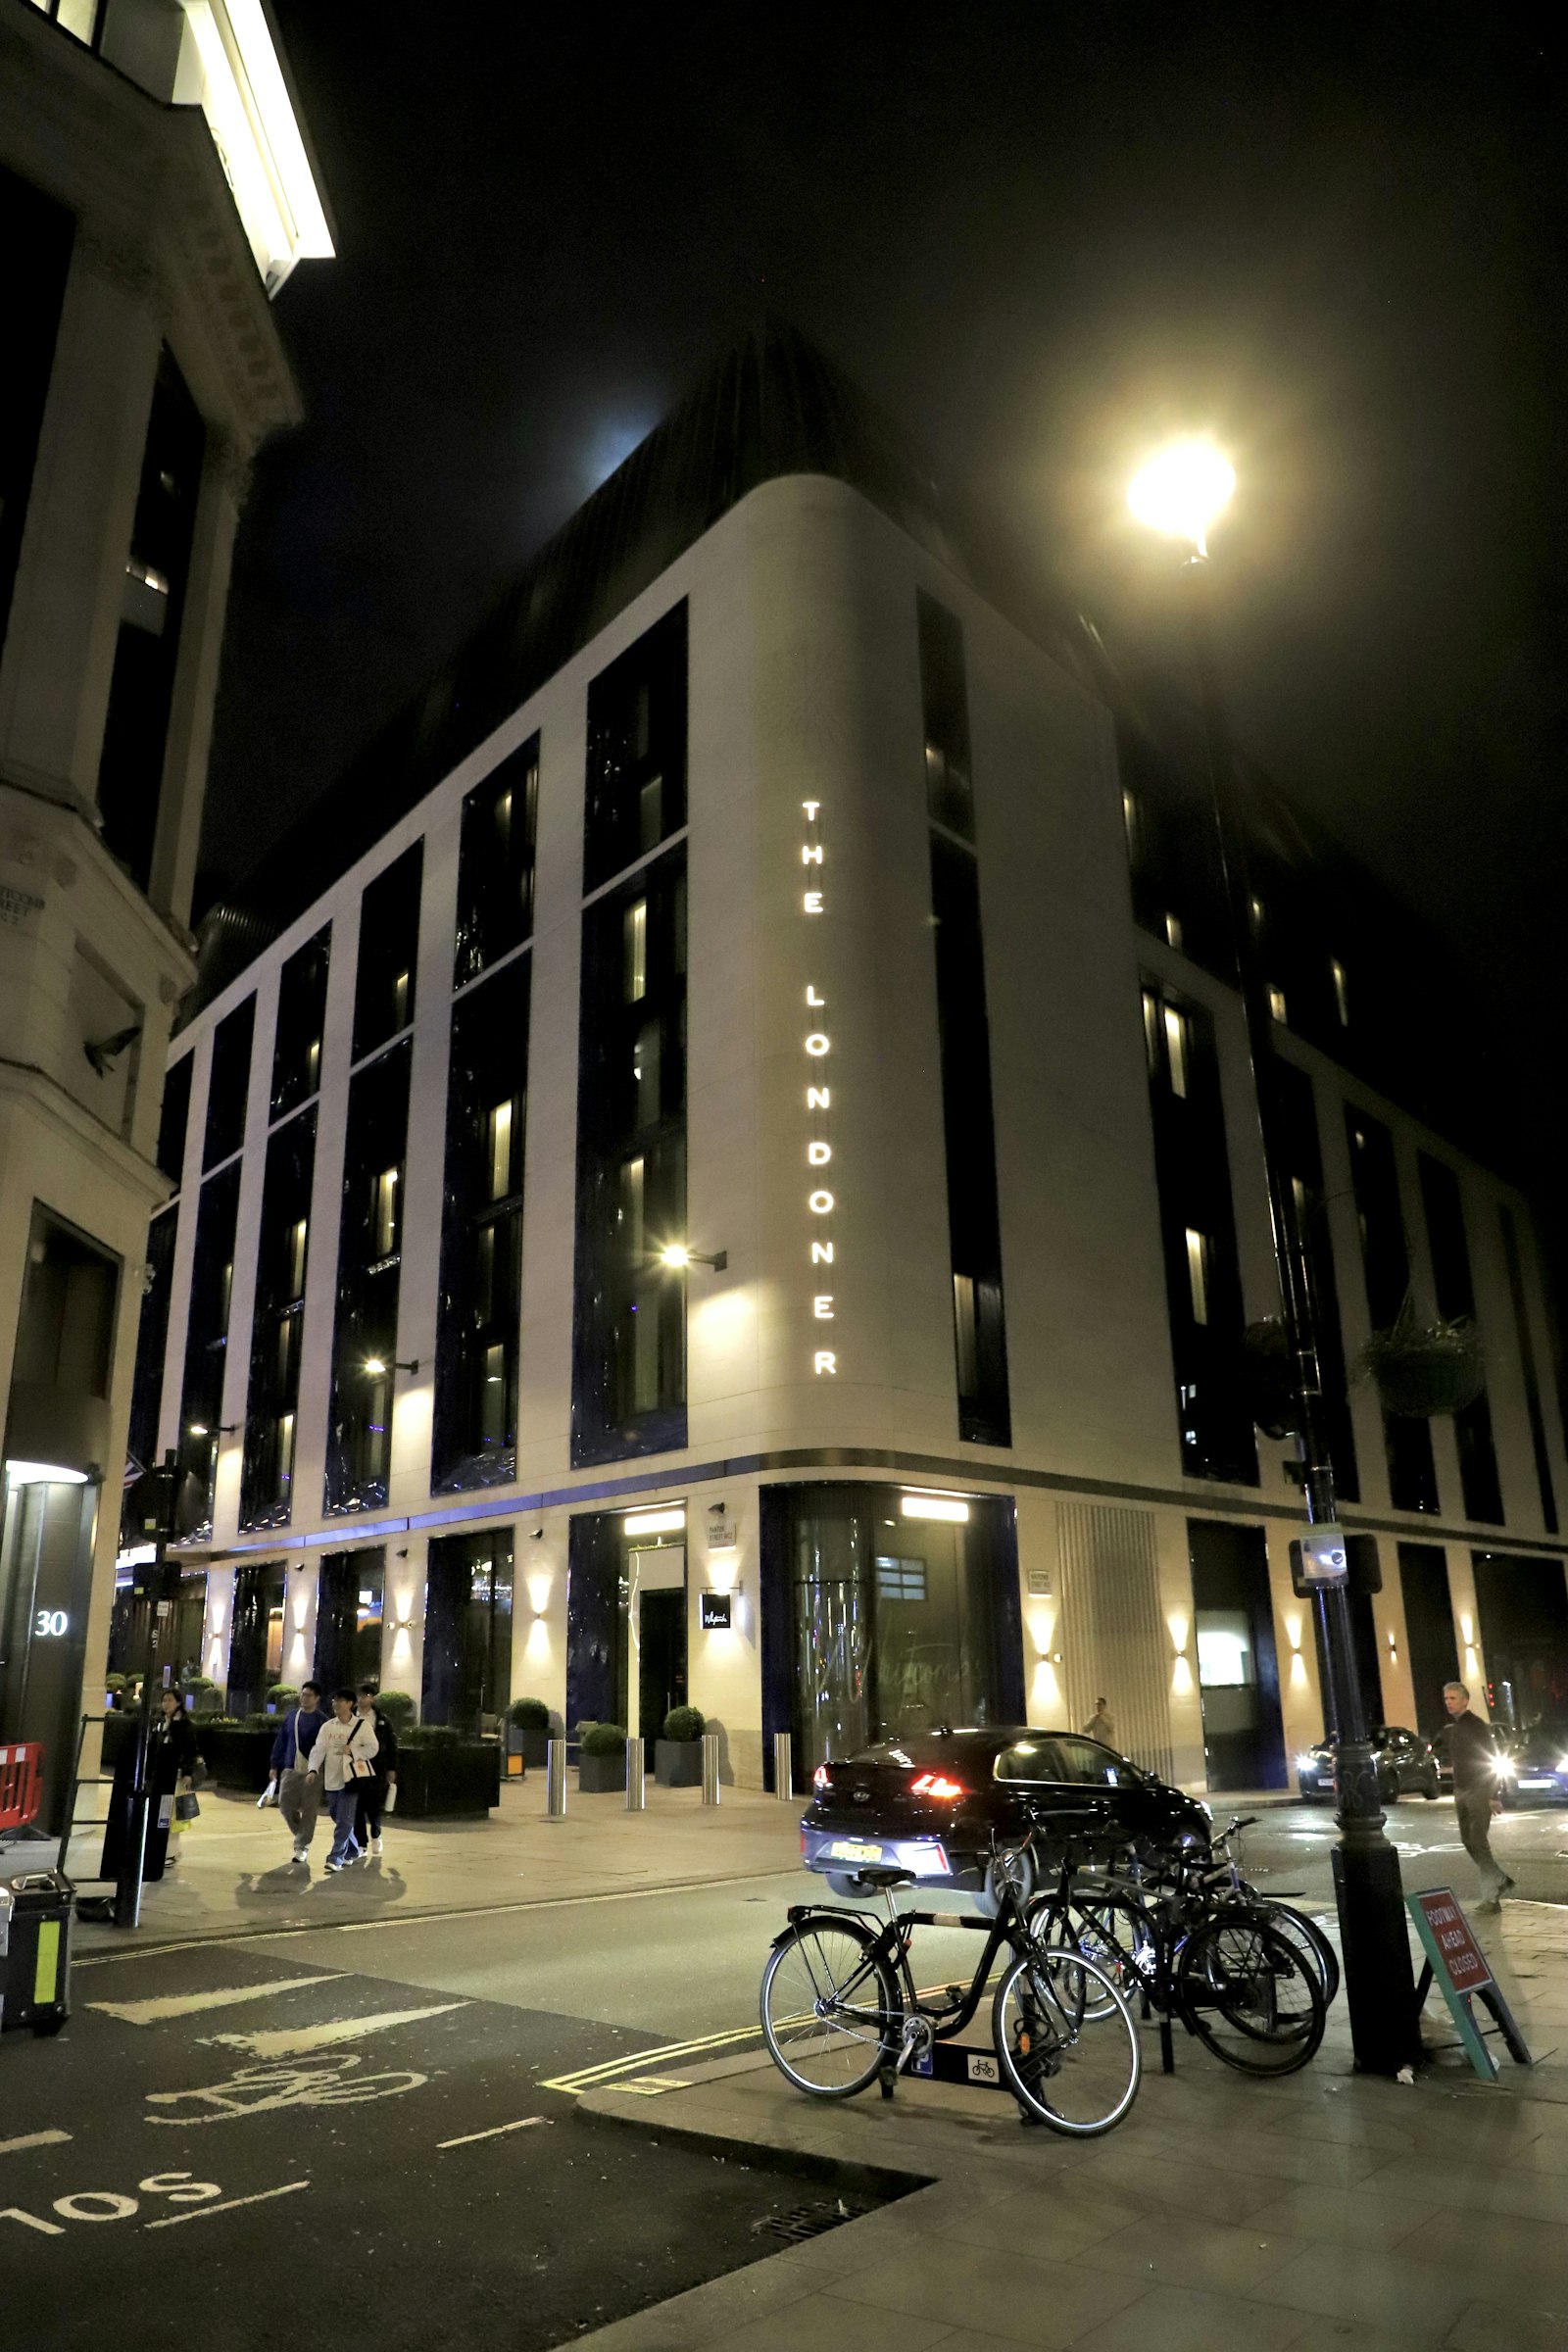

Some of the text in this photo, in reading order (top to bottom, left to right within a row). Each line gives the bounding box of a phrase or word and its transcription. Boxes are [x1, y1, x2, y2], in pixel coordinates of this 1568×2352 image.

[802, 801, 836, 1375] THE LONDONER
[34, 1610, 69, 1637] 30
[1425, 1905, 1457, 1927] FOOTWAY
[1441, 1929, 1466, 1950] AHEAD
[1449, 1952, 1479, 1977] CLOSED
